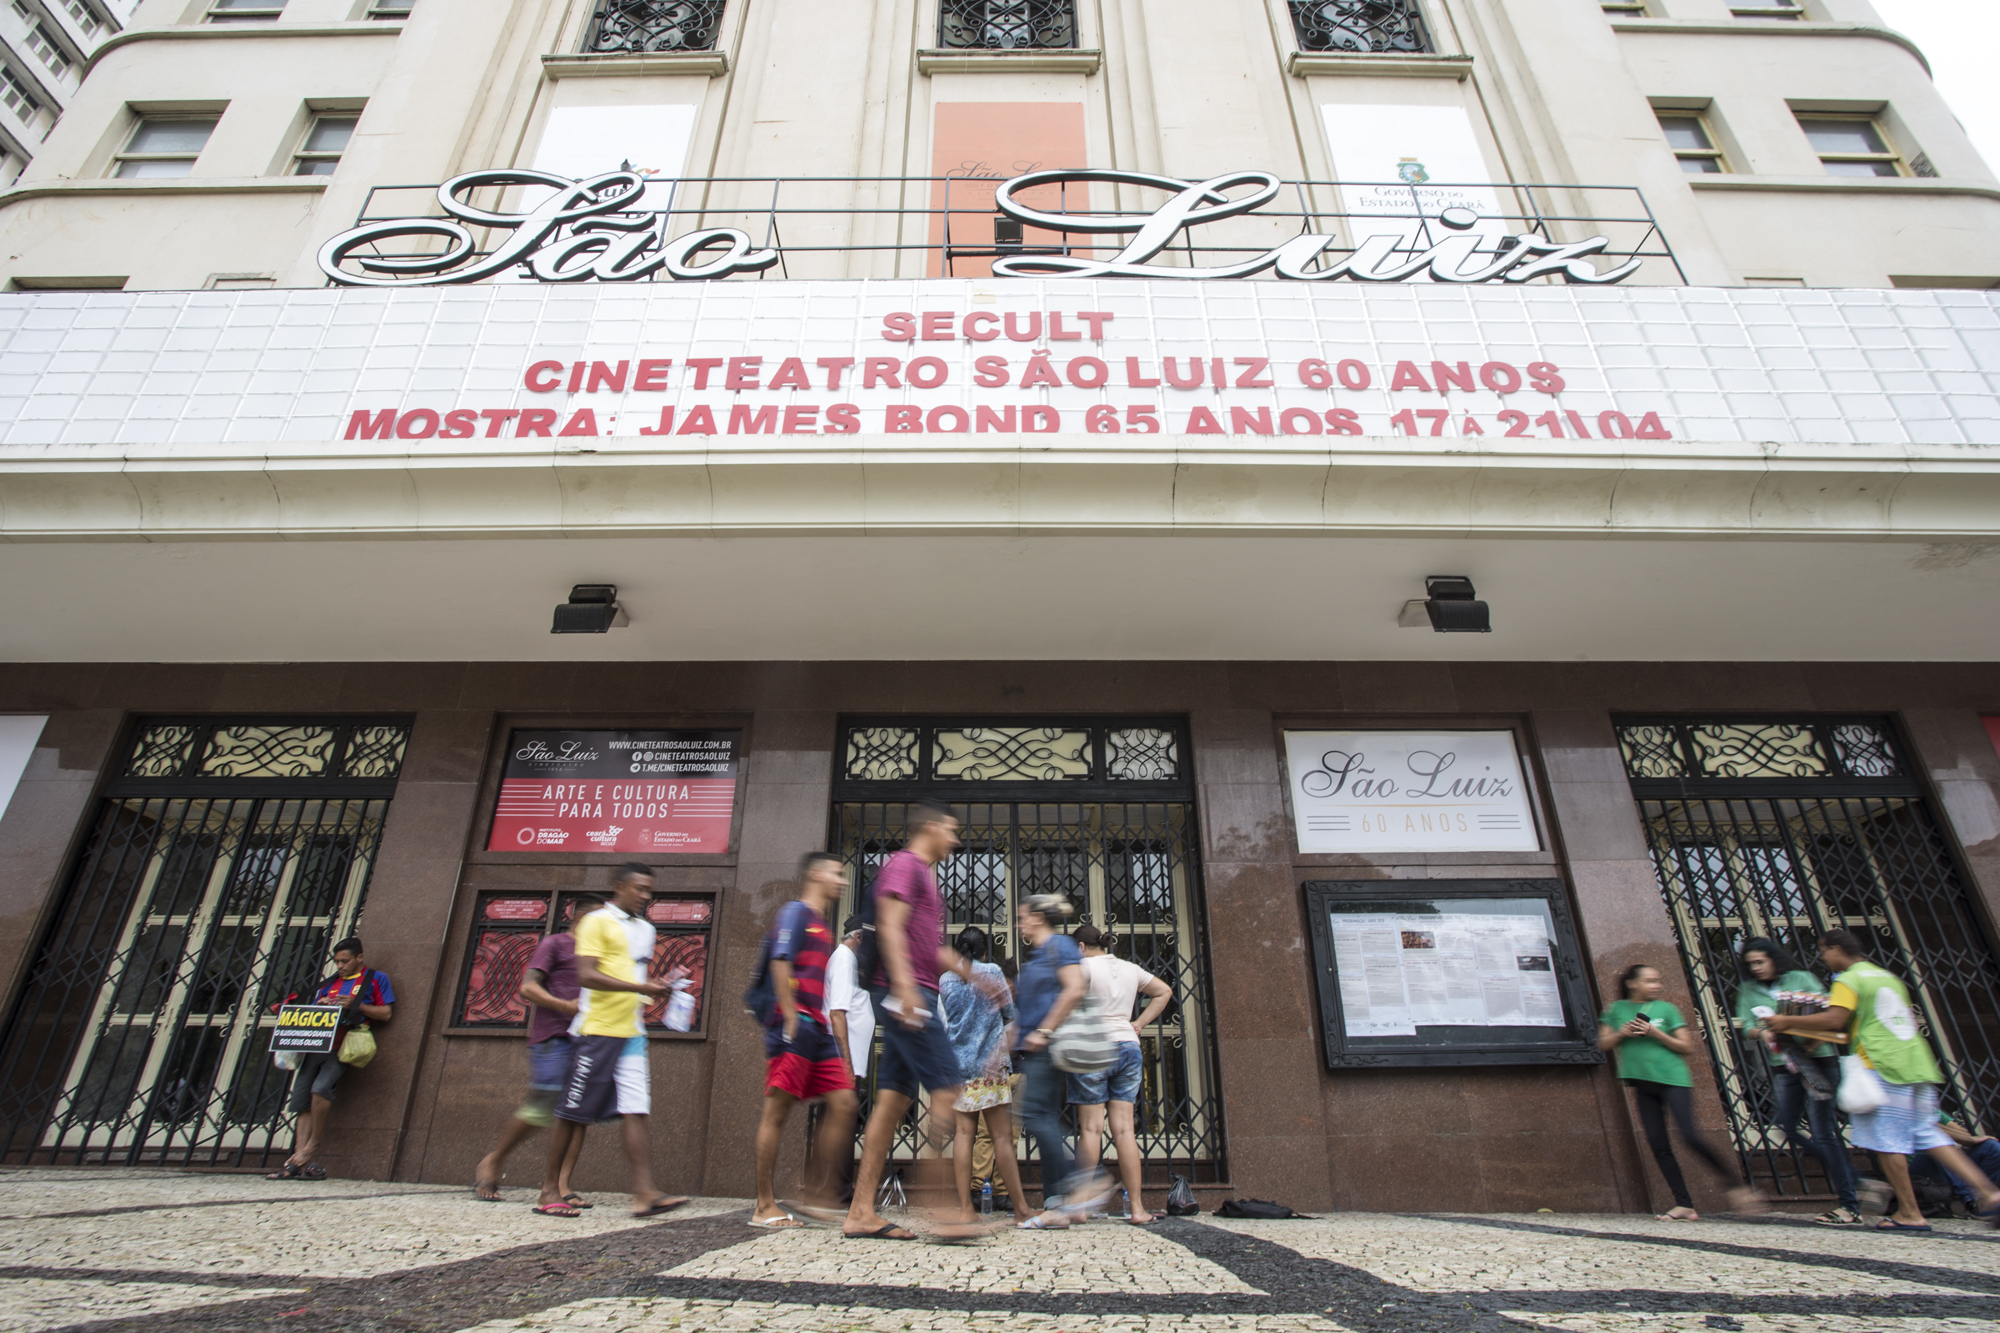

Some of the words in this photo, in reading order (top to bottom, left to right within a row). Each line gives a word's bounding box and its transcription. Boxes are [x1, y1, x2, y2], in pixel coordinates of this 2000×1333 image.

[317, 168, 778, 285] São
[991, 168, 1642, 284] Luiz
[881, 311, 1114, 342] SECULT
[973, 349, 1109, 388] SÃO
[1125, 357, 1274, 388] LUIZ
[1298, 358, 1371, 390] 60
[1390, 360, 1566, 394] ANOS
[343, 408, 616, 440] MOSTRA:
[639, 403, 861, 436] JAMES
[884, 404, 1061, 434] BOND
[1085, 404, 1160, 434] 65
[1185, 406, 1363, 436] ANOS
[1391, 408, 1449, 437] 17
[516, 740, 555, 760] São
[555, 740, 600, 760] Luiz
[608, 741, 732, 750] WWW.CINETEATROSAOLUIZ.COM.BR
[654, 752, 731, 761] CINETEATROSAOLUIZ
[642, 763, 729, 772] T.ME/CINETEATROSAOLUIZ
[1300, 750, 1400, 798] São
[1405, 750, 1514, 798] Luiz
[543, 785, 586, 800] ARTE
[595, 785, 604, 800] E
[612, 785, 690, 801] CULTURA
[558, 803, 602, 818] PARA
[613, 803, 669, 818] TODOS
[1362, 813, 1388, 833] 60
[1404, 812, 1468, 833] ANOS
[277, 1008, 339, 1028] MÁGICAS
